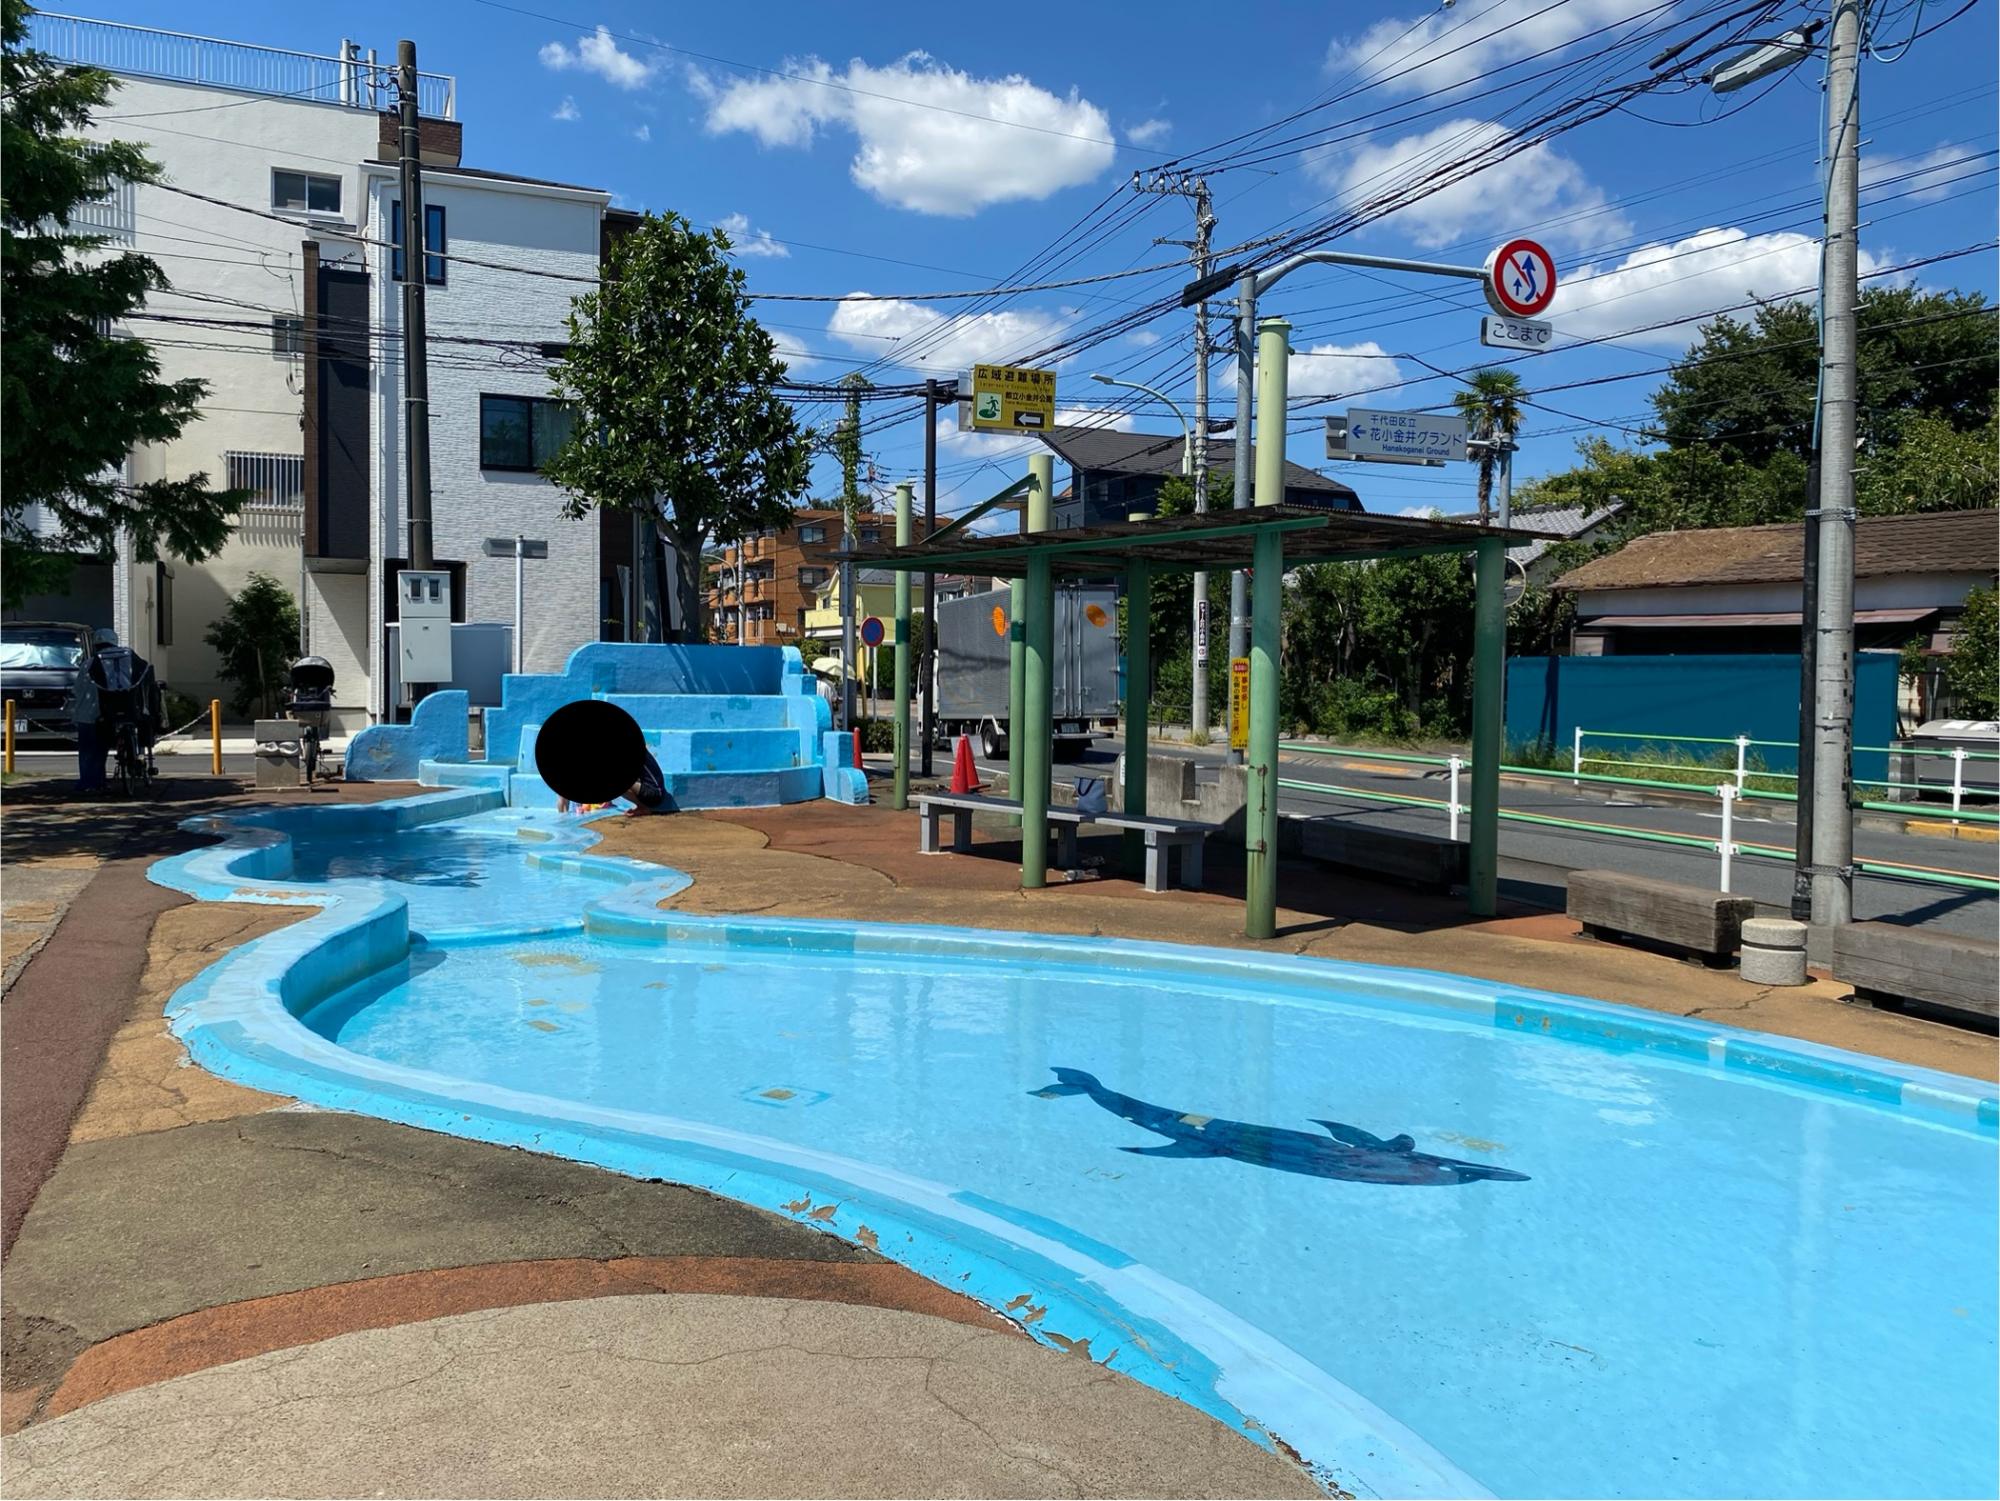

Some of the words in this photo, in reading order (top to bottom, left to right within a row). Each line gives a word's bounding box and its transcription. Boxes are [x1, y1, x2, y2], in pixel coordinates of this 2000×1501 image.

[1493, 322, 1548, 343] ここまで
[977, 367, 1054, 386] 広域避難場所
[1370, 414, 1416, 428] 千代田区立
[1370, 428, 1463, 446] 花小金井グランド
[1382, 443, 1424, 455] Hanakoganei
[1427, 446, 1450, 456] Ground
